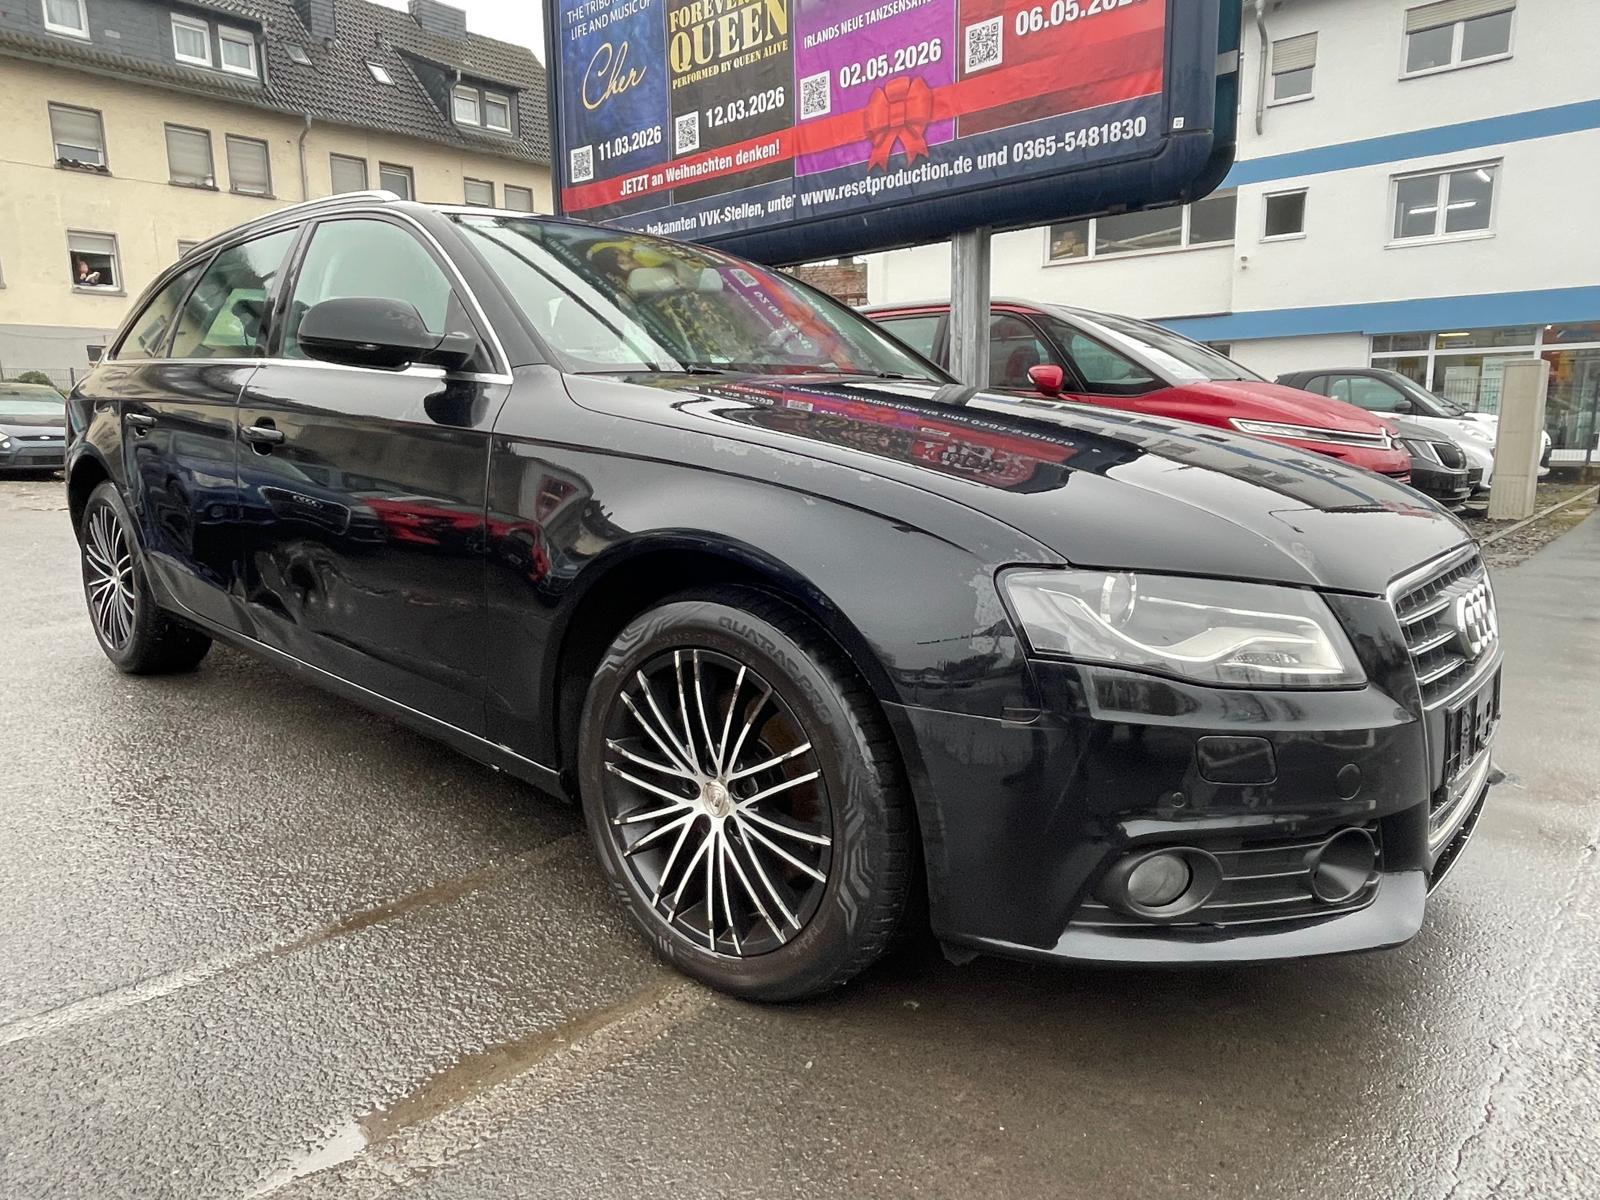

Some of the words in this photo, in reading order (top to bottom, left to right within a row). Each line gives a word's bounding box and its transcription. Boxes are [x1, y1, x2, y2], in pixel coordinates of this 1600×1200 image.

[567, 6, 584, 24] THE
[585, 0, 618, 15] TRIBU
[571, 22, 588, 40] LIFE
[589, 14, 608, 33] AND
[610, 0, 638, 23] MUSIC
[670, 0, 750, 32] FOREV
[804, 23, 839, 49] IRLANDS
[841, 14, 864, 35] NEUE
[865, 0, 932, 25] TANZSENSA
[1015, 0, 1143, 35] 06.05.2
[670, 0, 788, 74] QUEEN
[582, 40, 647, 110] Cher
[672, 66, 719, 90] PERFORMED
[721, 60, 733, 74] BY
[733, 53, 761, 68] QUEEN
[763, 40, 788, 58] ALIVE
[839, 38, 941, 88] 02.05.2026
[706, 86, 785, 128] 12.03.2026
[598, 126, 662, 161] 11.03.2026
[620, 174, 650, 196] JETZT
[651, 172, 663, 186] an
[665, 152, 732, 183] Weihnachten
[736, 139, 780, 163] denken!
[647, 216, 697, 235] bekannten
[699, 202, 764, 227] VVK-Stellen,
[768, 194, 797, 214] unter
[800, 156, 972, 206] www.resetproduction.de
[977, 146, 1007, 170] und
[1013, 116, 1147, 163] 0365-5481830
